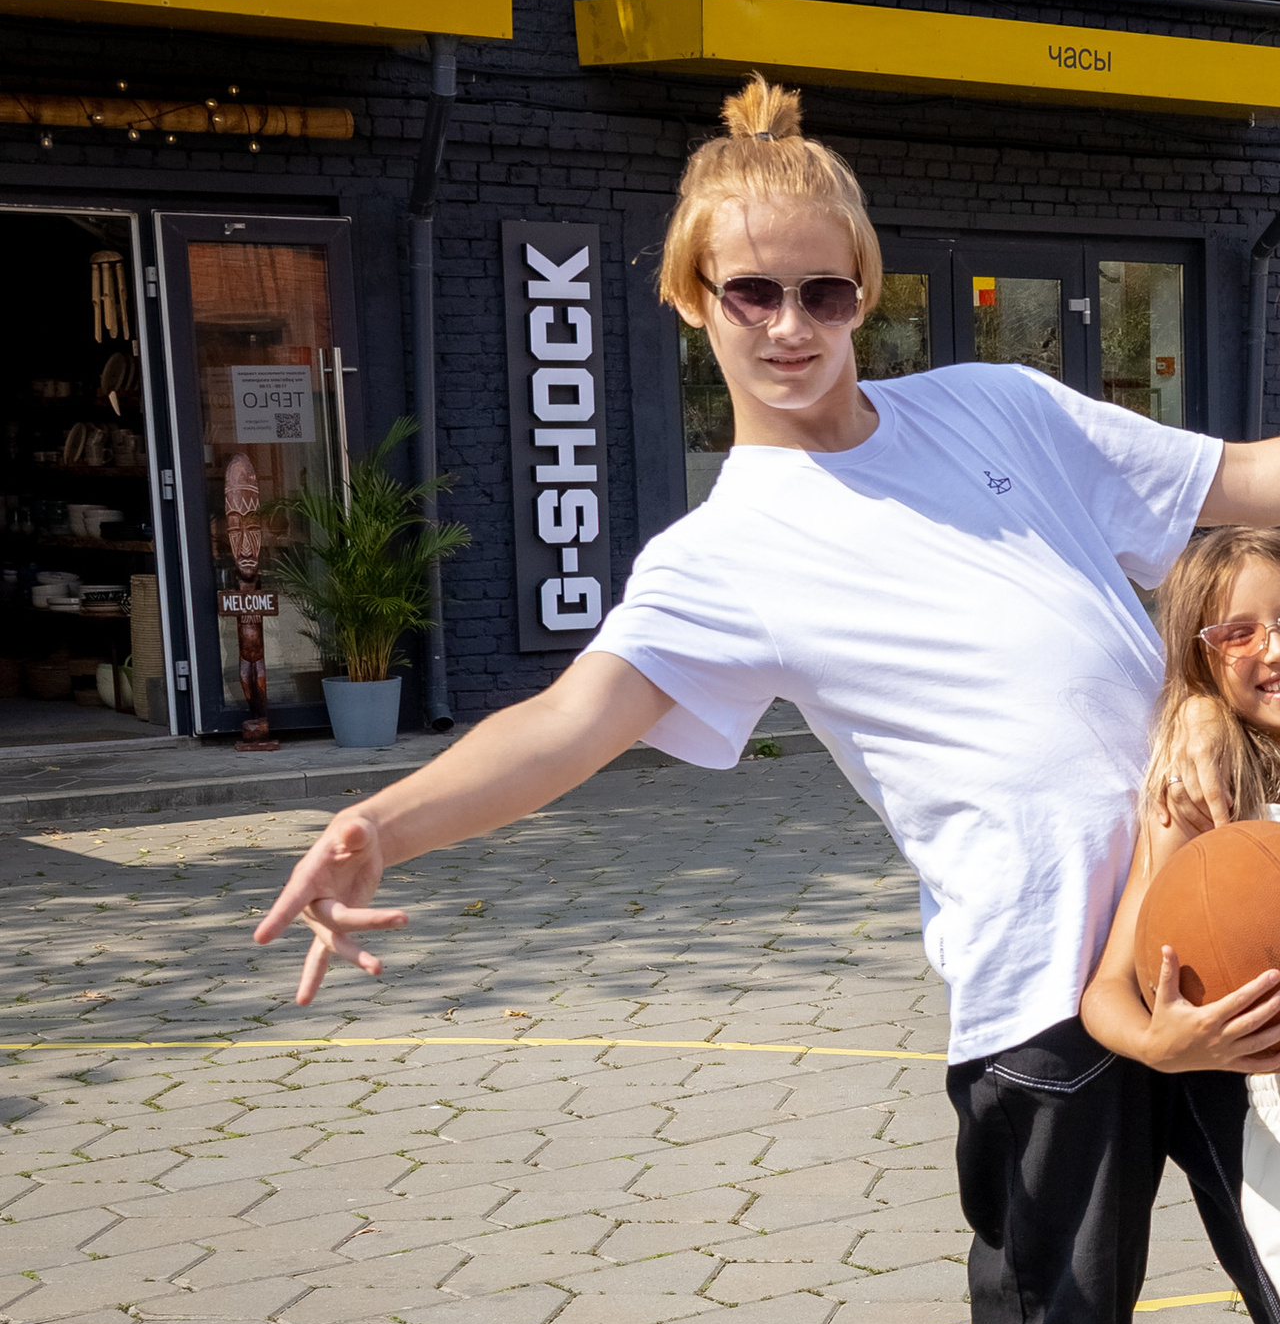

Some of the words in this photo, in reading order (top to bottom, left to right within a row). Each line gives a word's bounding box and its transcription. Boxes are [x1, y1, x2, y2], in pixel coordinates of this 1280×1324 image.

[1048, 45, 1112, 72] часы
[525, 243, 603, 631] G-SHOCK
[222, 594, 275, 612] WELCOME
